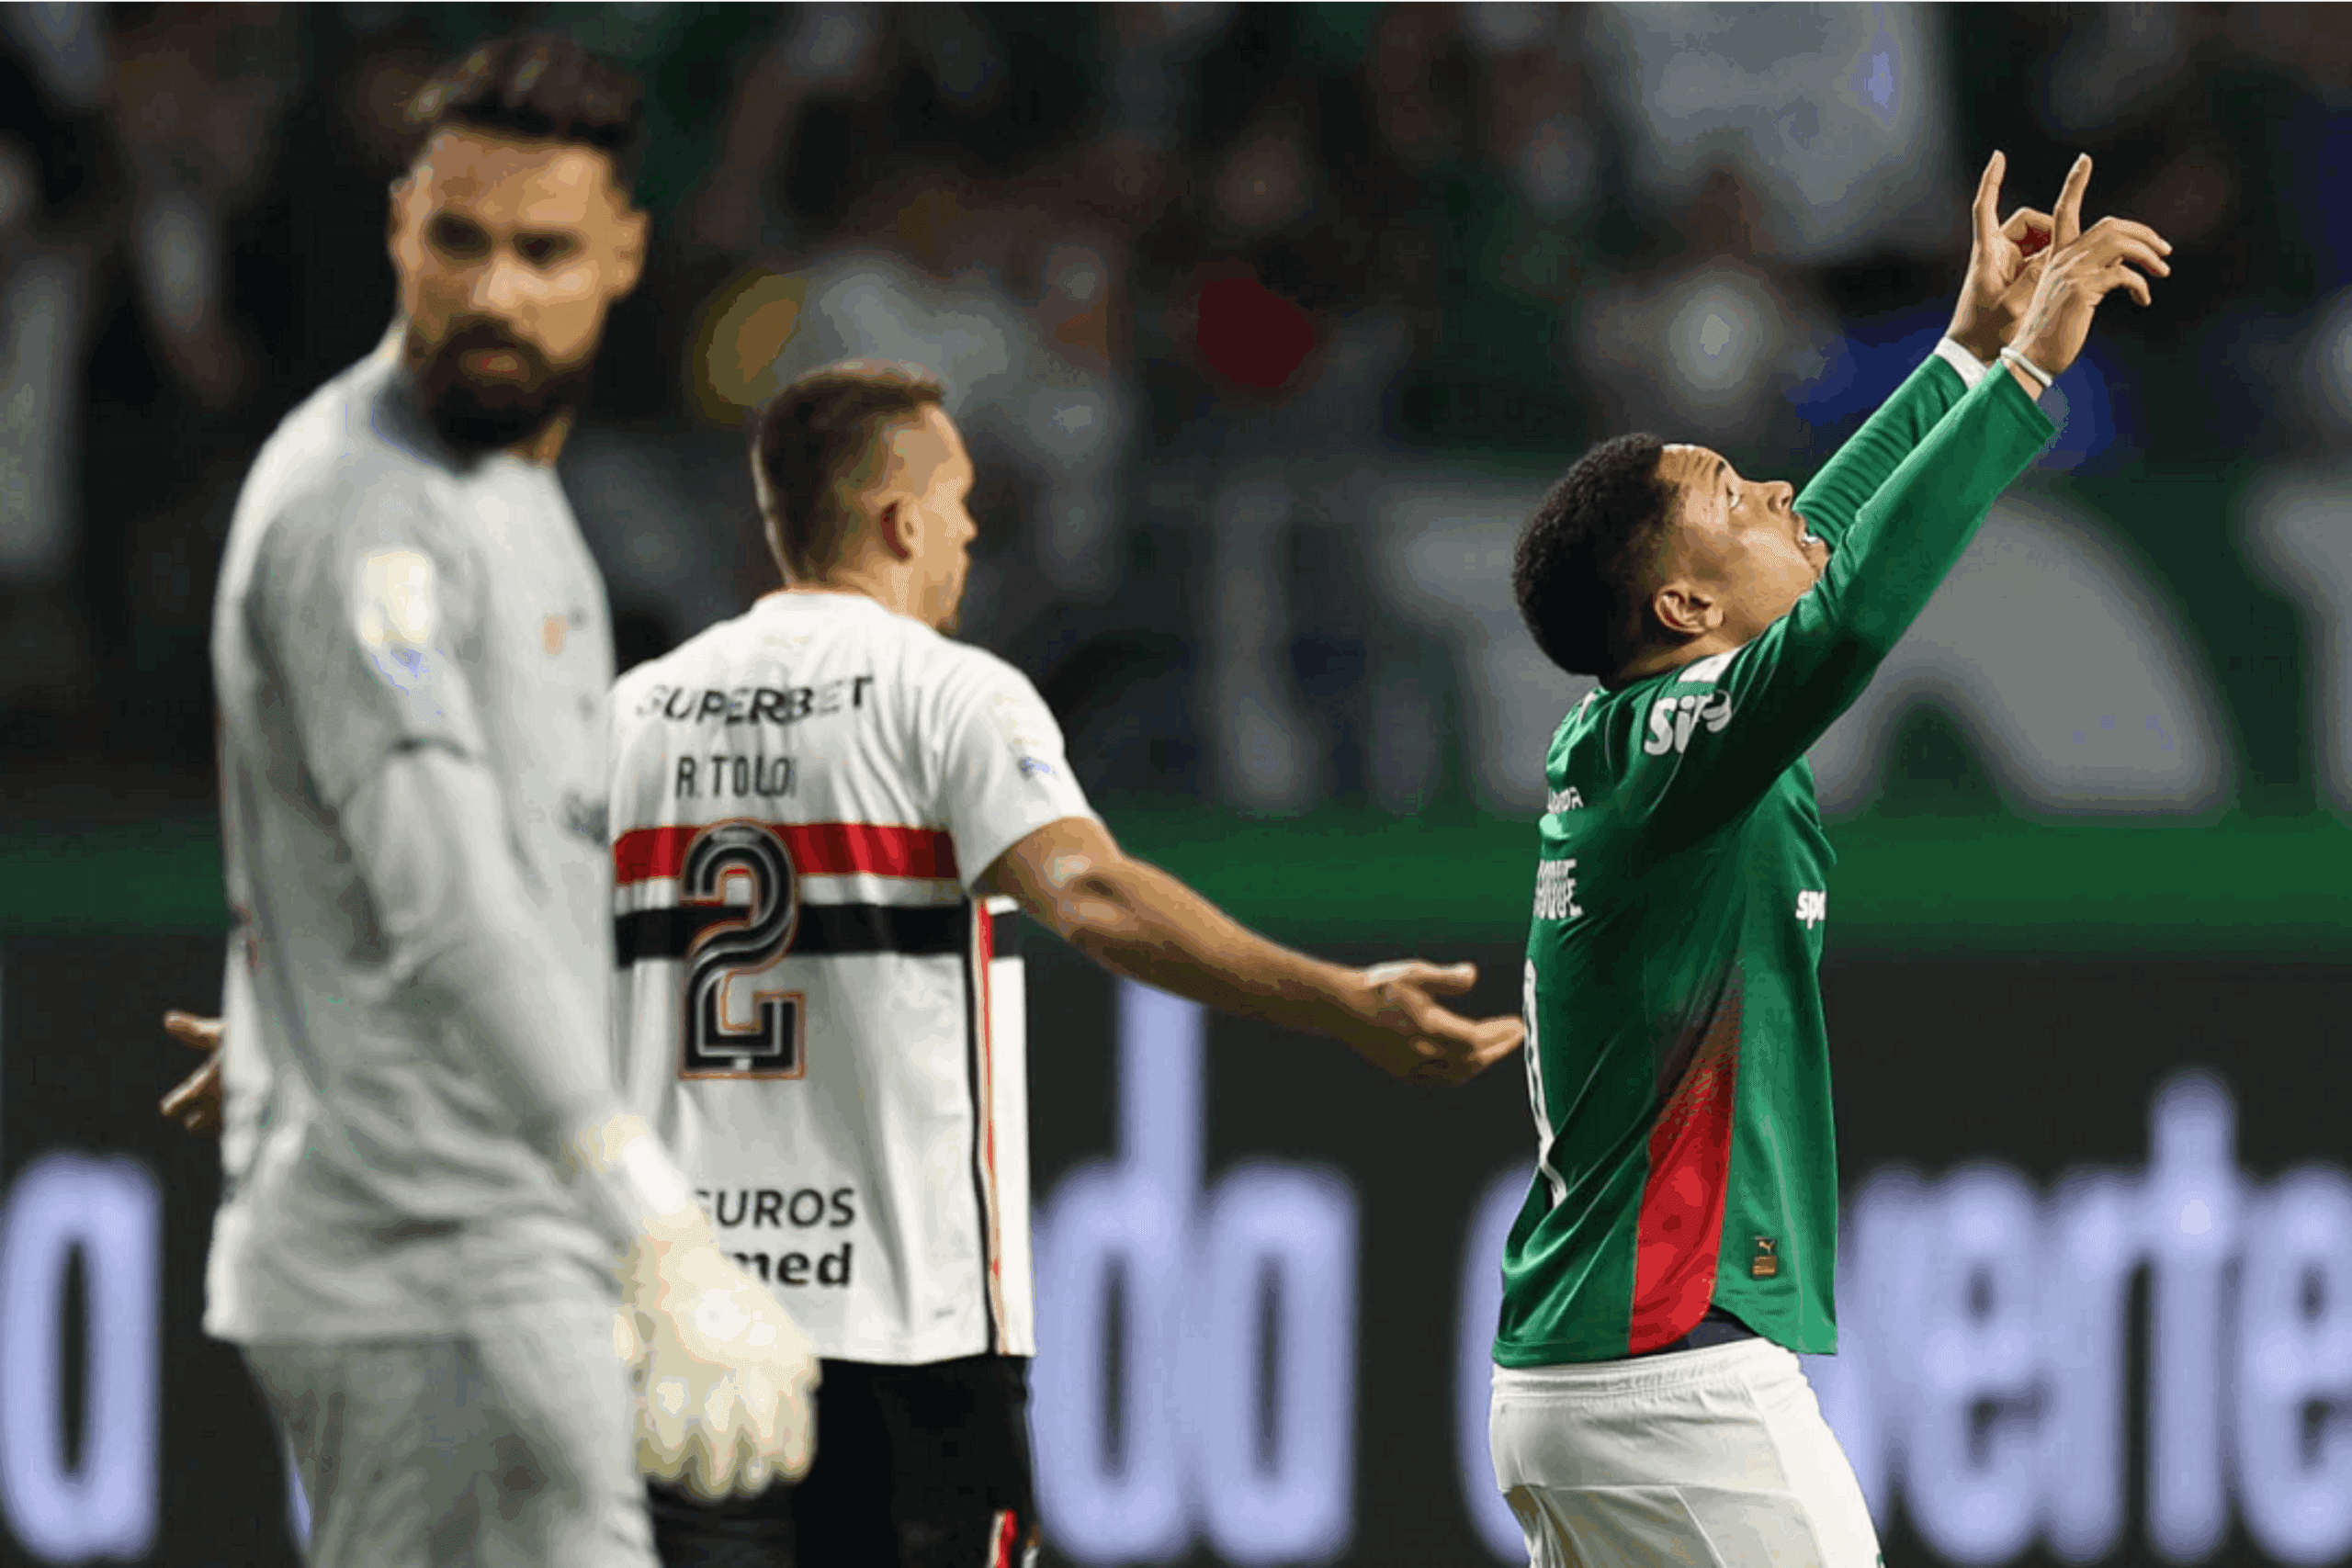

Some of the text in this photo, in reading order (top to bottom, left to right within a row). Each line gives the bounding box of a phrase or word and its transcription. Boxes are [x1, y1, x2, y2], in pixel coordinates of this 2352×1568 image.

[635, 674, 874, 727] SUPERBET
[678, 817, 807, 1080] 2
[695, 1187, 855, 1228] UROS
